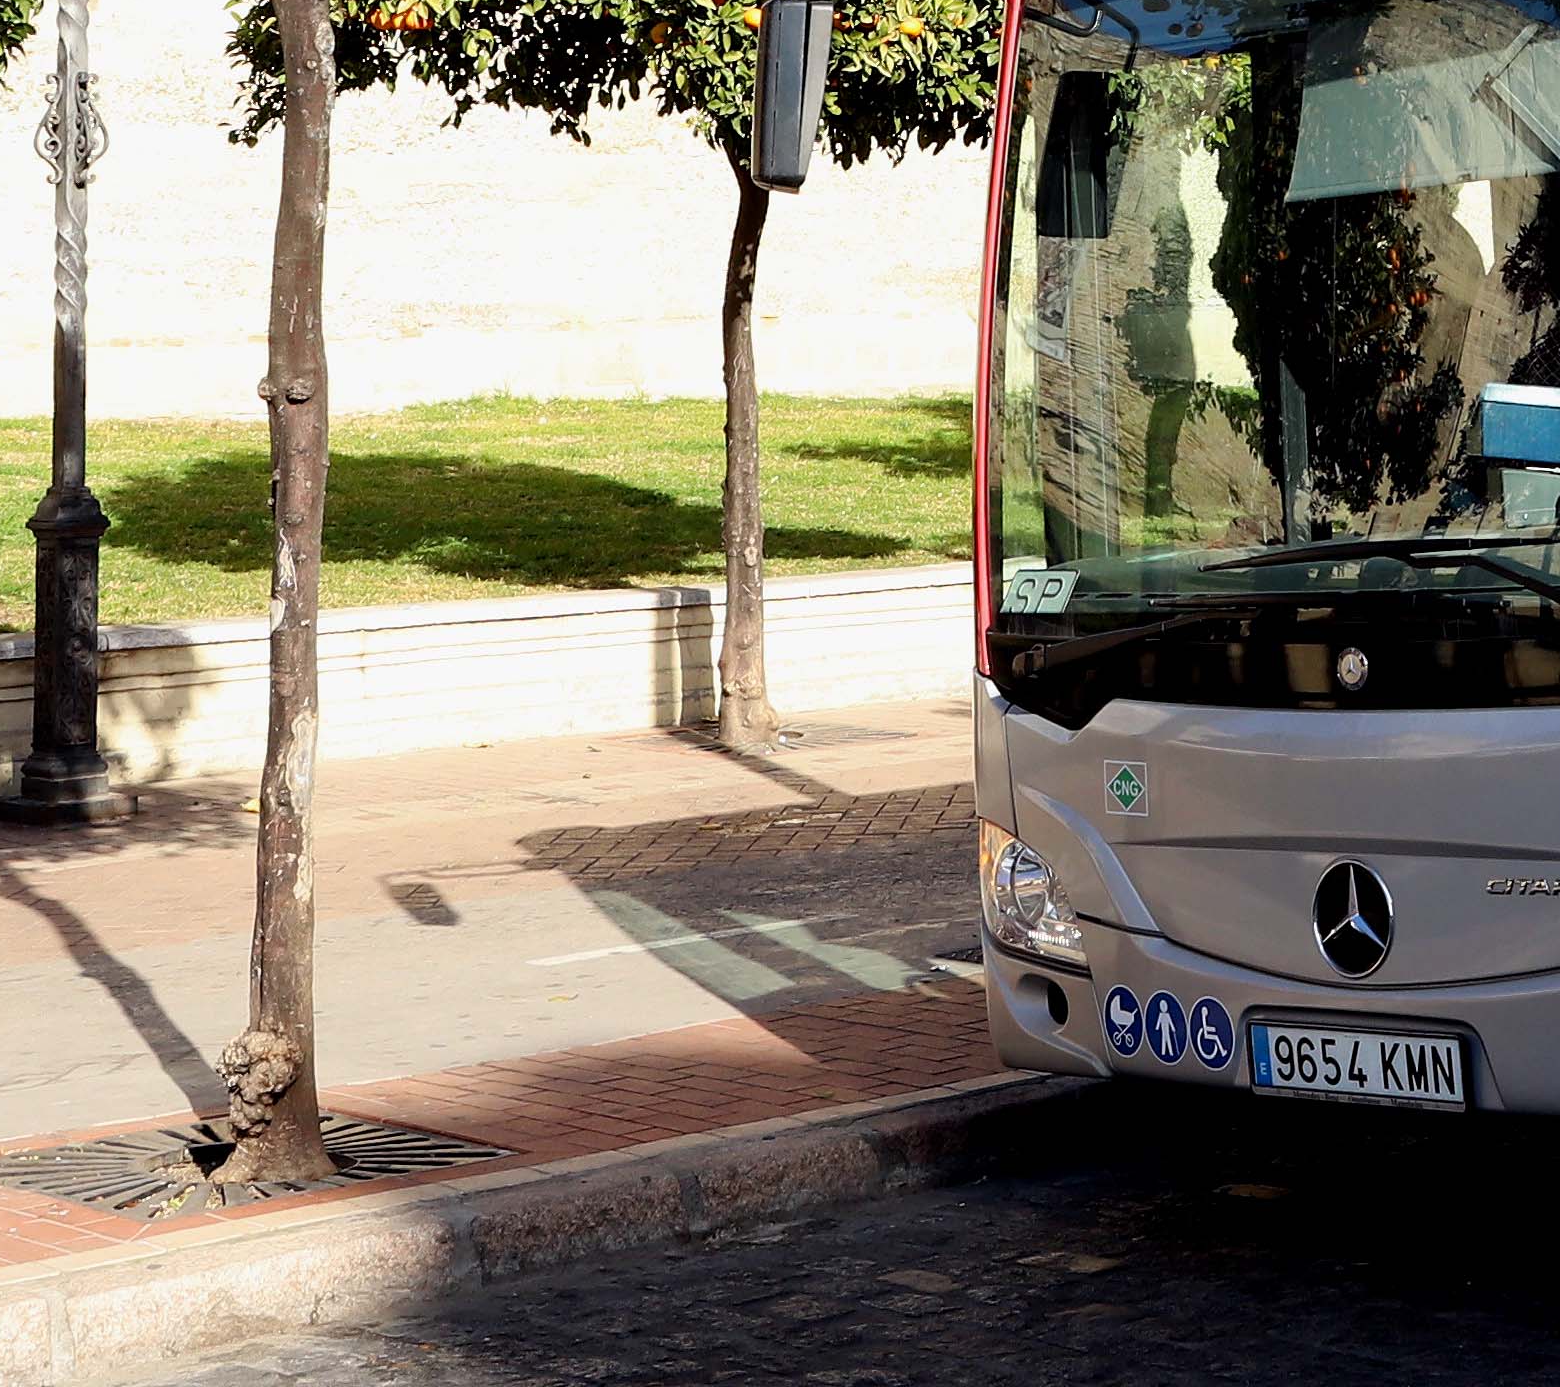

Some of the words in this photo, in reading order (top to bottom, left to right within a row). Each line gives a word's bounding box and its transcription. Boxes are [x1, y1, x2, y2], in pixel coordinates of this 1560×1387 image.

[1009, 578, 1064, 613] SP
[1113, 779, 1139, 797] CNG
[1274, 1035, 1368, 1088] 9654
[1379, 1040, 1456, 1096] KMN
